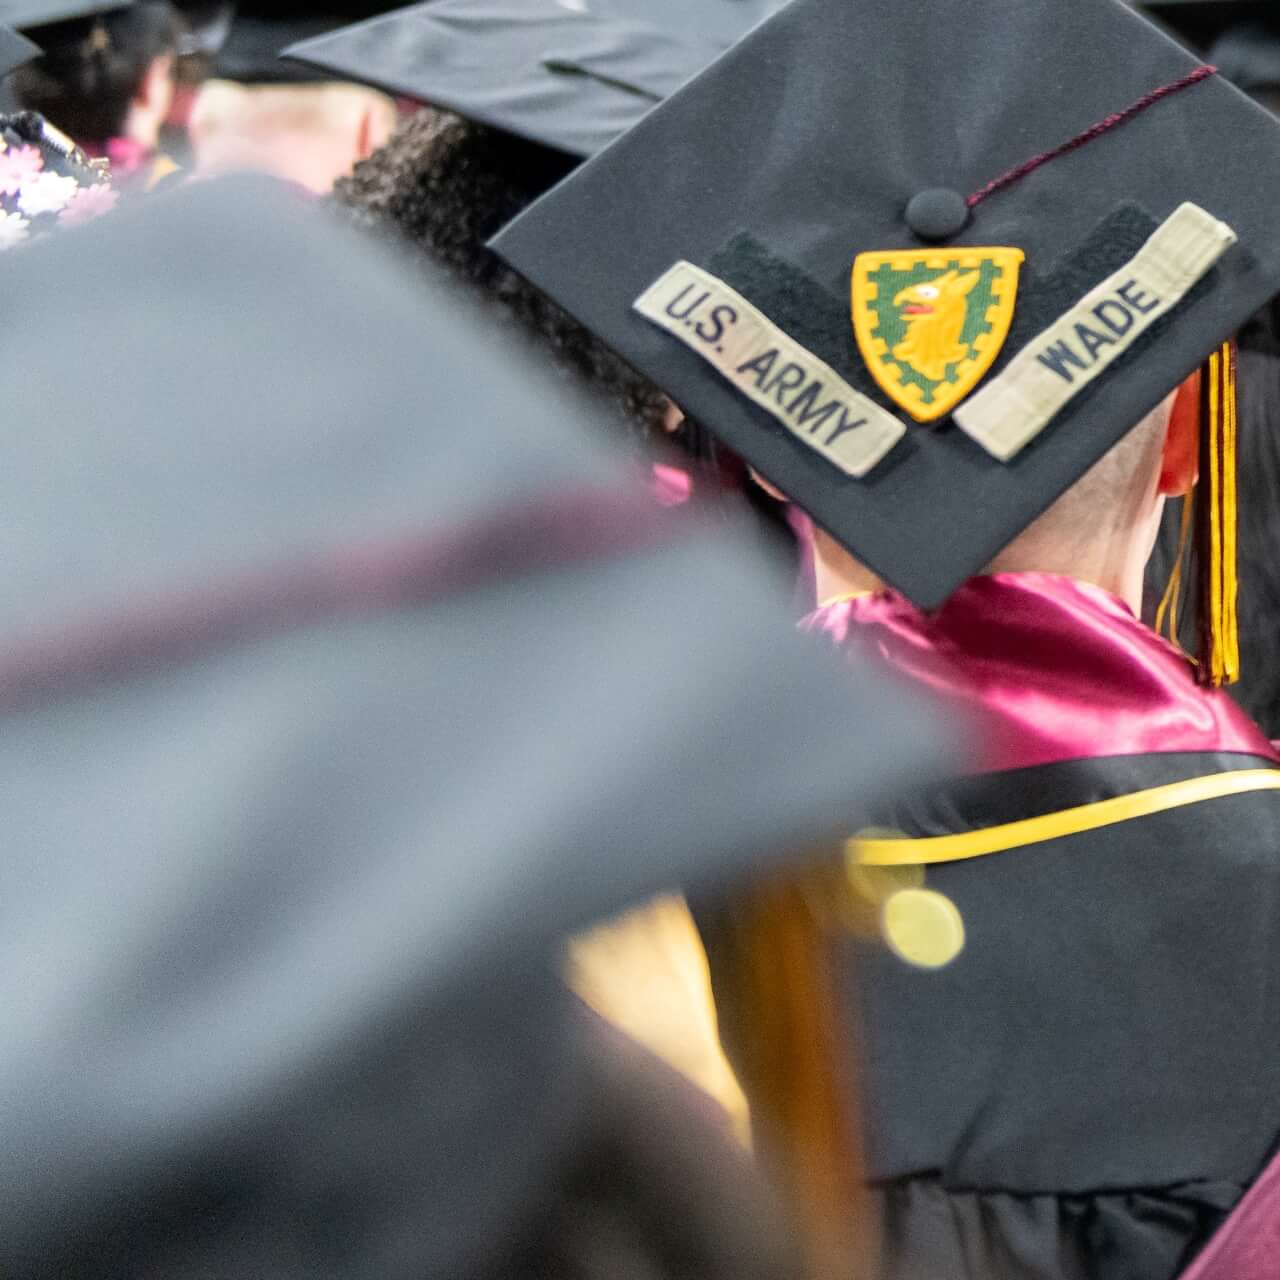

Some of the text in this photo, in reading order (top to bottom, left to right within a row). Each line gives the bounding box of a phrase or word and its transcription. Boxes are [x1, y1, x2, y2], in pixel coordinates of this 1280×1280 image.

[665, 283, 867, 447] U.S. ARMY
[1036, 278, 1160, 384] WADE
